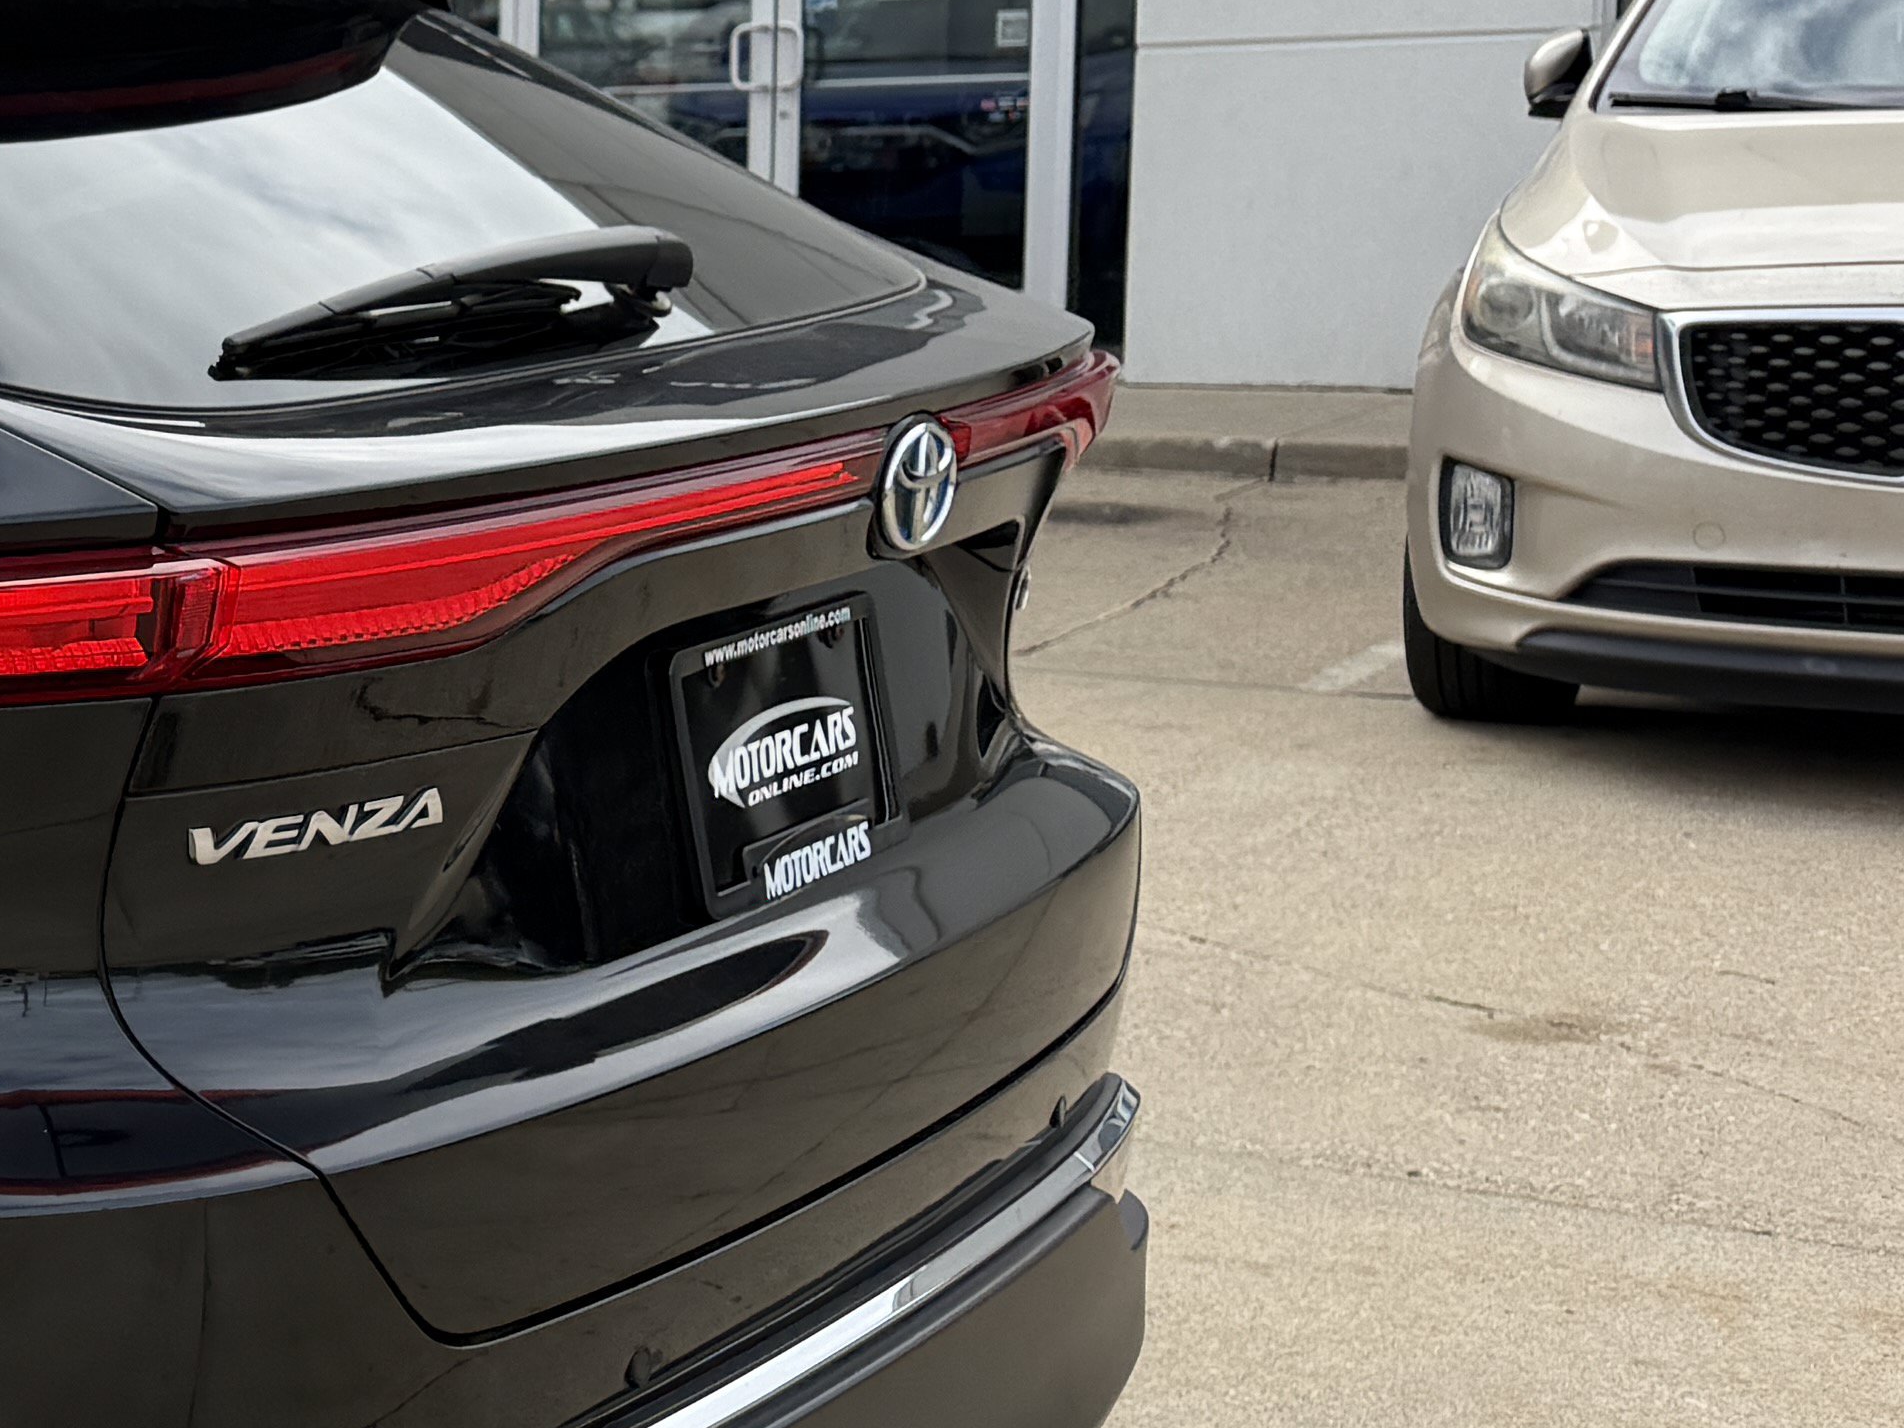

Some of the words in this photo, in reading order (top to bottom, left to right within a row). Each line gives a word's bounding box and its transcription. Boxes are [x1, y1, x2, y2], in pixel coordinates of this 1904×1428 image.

[703, 605, 852, 667] www.motorcarsonline.com
[709, 705, 858, 800] MOTORCARS
[746, 751, 860, 808] ONLINE.COM
[188, 786, 444, 866] VENZA
[763, 820, 872, 900] MOTORCARS
